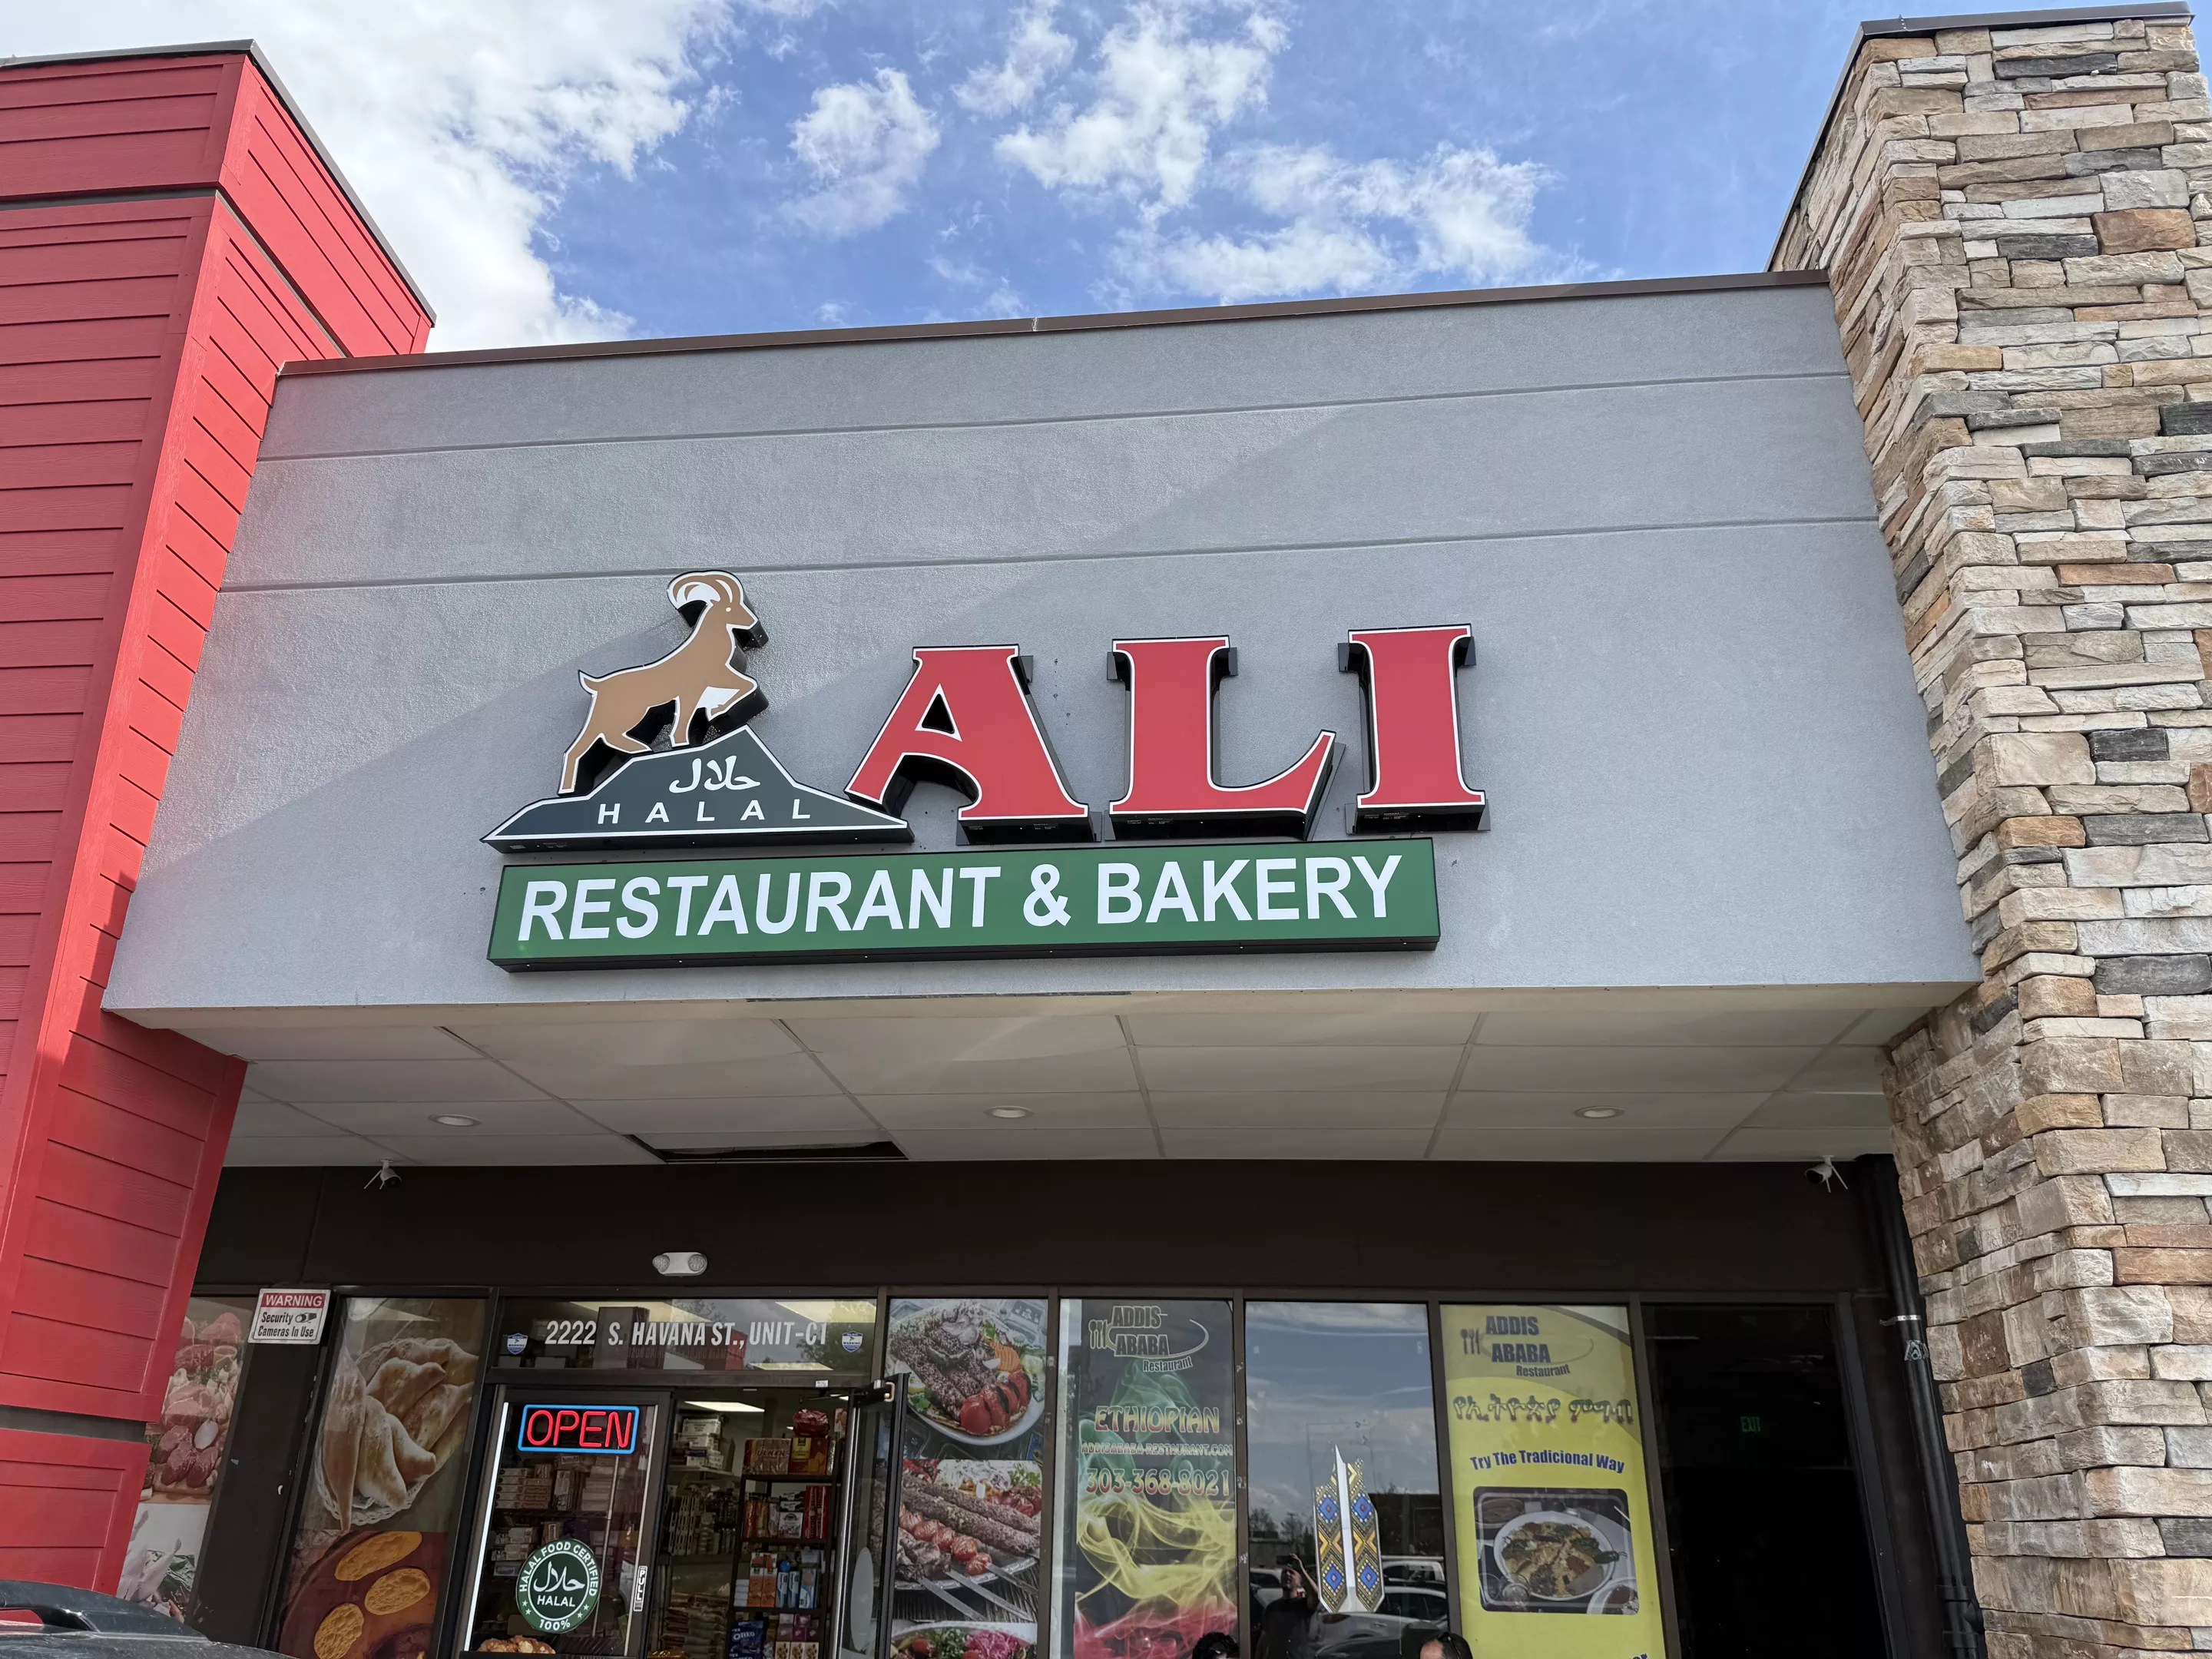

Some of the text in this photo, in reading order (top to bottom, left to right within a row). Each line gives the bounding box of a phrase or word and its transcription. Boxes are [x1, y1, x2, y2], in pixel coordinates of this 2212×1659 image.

[843, 624, 1486, 820] ALI
[669, 754, 761, 793] حلال
[597, 798, 811, 825] HALAL
[517, 854, 1402, 942] RESTAURANT & BAKERY
[266, 1294, 323, 1306] WARNING
[261, 1311, 293, 1325] Security
[1112, 1306, 1161, 1328] ADDIS
[1485, 1315, 1539, 1336] ADDIS
[257, 1325, 314, 1337] Cameras In Use
[545, 1320, 597, 1345] 2222
[608, 1321, 624, 1346] S.
[631, 1321, 705, 1346] HAVANA
[710, 1321, 745, 1349] ST.,
[1114, 1333, 1170, 1356] ABABA
[1491, 1343, 1551, 1363] ABABA
[1143, 1356, 1192, 1372] Restaurant
[1515, 1363, 1571, 1377] Restaurant
[526, 1409, 633, 1449] OPEN
[1094, 1406, 1220, 1433] ETHIOPIAN
[1740, 1416, 1761, 1433] EXIT
[1469, 1449, 1625, 1474] Try The Tradicional Way
[1085, 1468, 1230, 1496] 303-368-8021
[519, 1541, 599, 1596] HALAL FOOD CERTIFIED
[533, 1561, 585, 1592] حلال
[636, 1569, 646, 1601] PULL
[537, 1594, 575, 1608] HALAL
[539, 1618, 571, 1631] 100%
